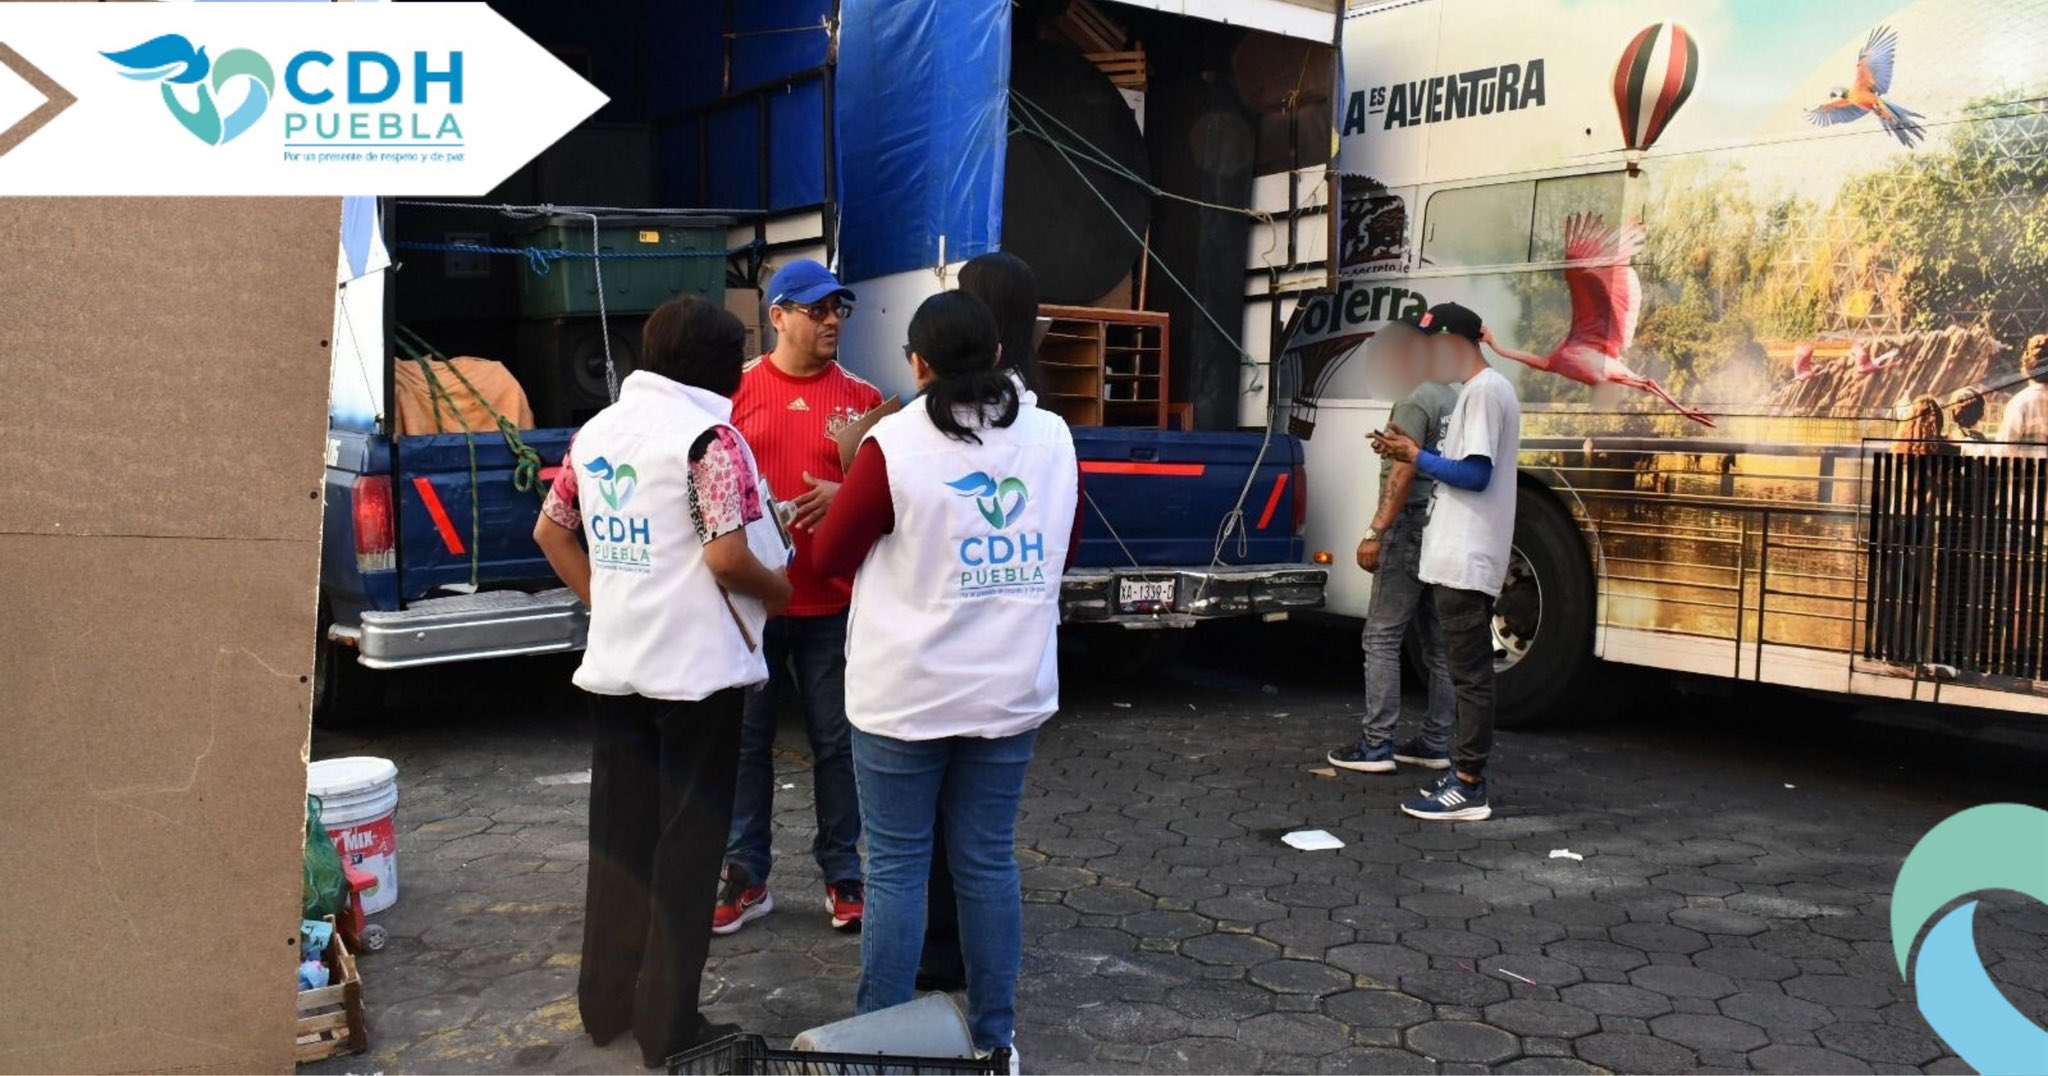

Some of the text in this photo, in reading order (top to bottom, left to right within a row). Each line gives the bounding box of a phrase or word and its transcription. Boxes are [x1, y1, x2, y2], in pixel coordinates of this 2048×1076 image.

[1369, 86, 1386, 107] ES
[1384, 58, 1546, 130] AVENTURA
[1302, 280, 1429, 336] oTerra
[591, 515, 650, 545] CDH
[594, 544, 650, 563] PUEBLA
[960, 532, 1044, 567] CDH
[960, 566, 1044, 586] PUEBLA
